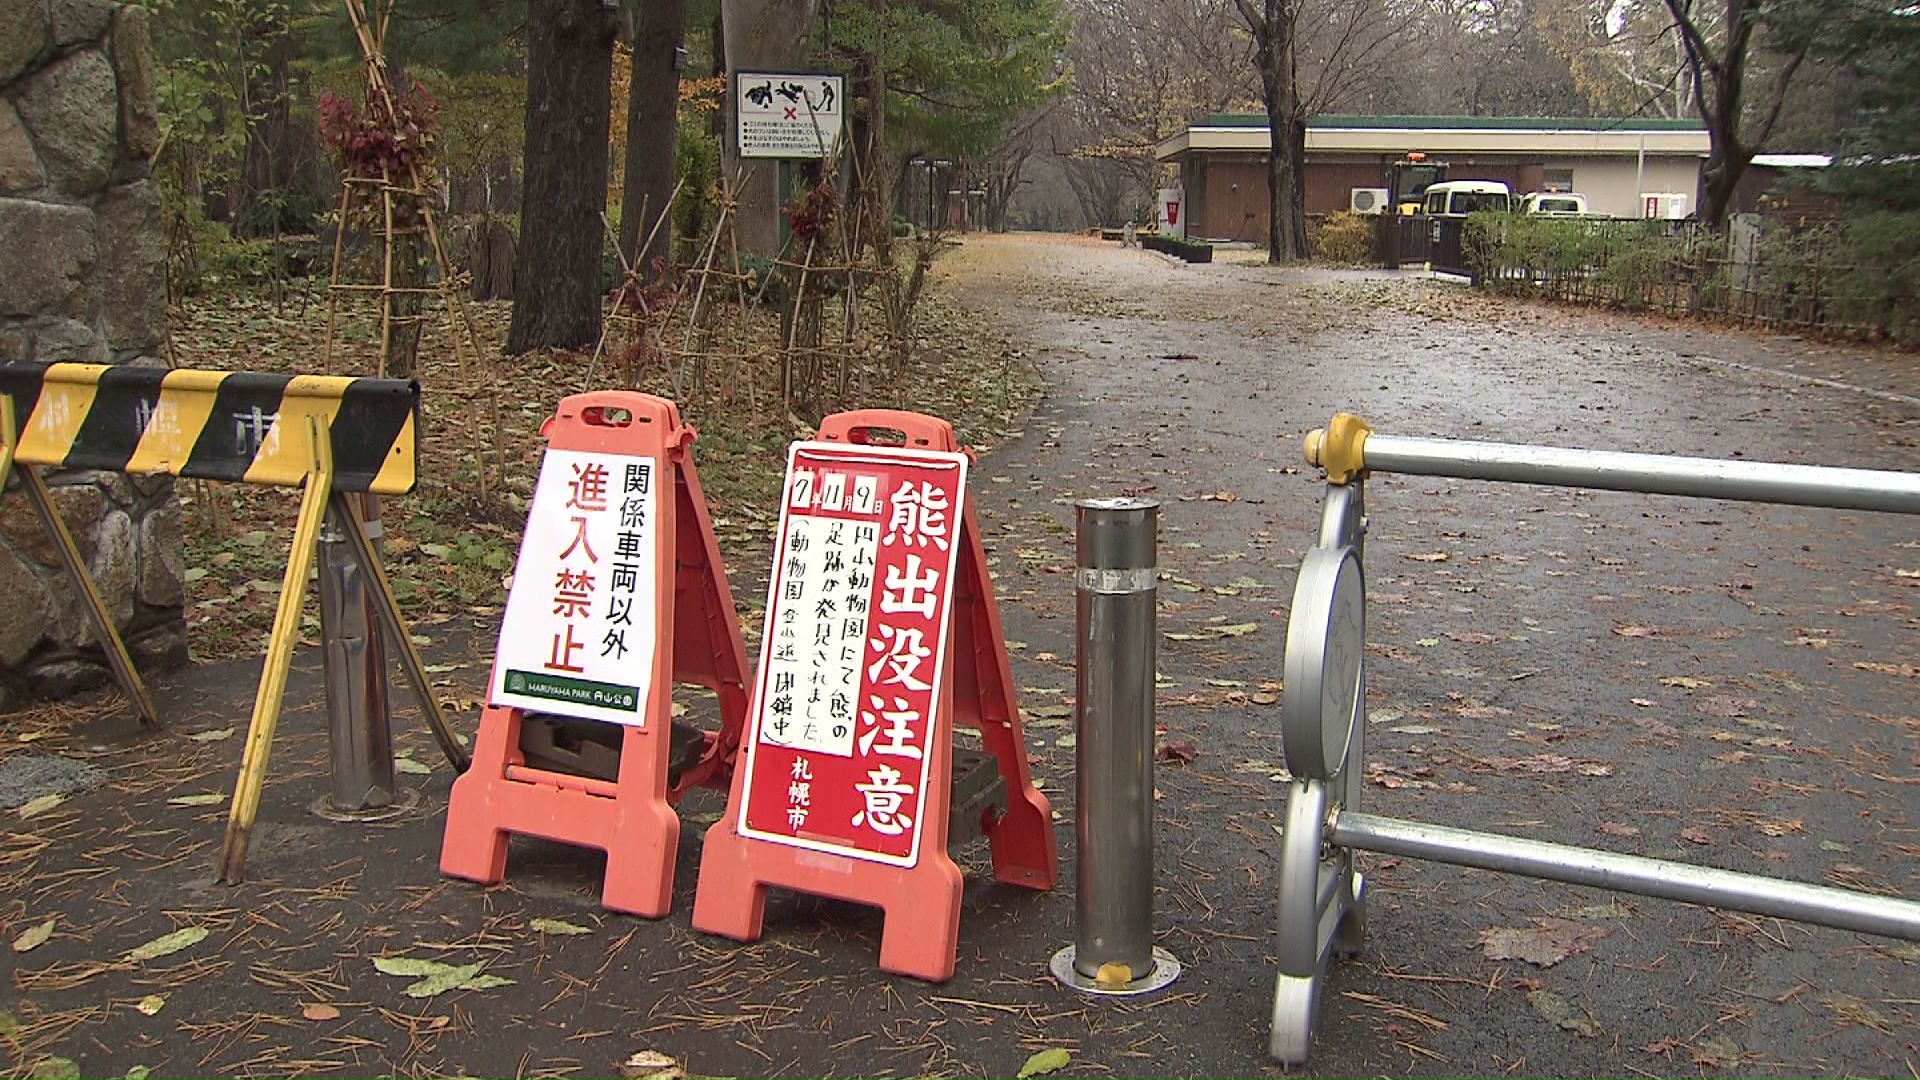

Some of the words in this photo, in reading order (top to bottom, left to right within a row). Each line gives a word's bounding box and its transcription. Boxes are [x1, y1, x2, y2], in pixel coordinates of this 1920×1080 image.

[543, 462, 610, 674] 進入禁止
[600, 463, 650, 660] 関係車両以外
[830, 525, 874, 738] 円山動物園にて熊の
[851, 479, 951, 835] 熊出没注意
[528, 682, 571, 697] MARUYAMA
[571, 688, 592, 700] PARK
[787, 755, 813, 831] 札幌市
